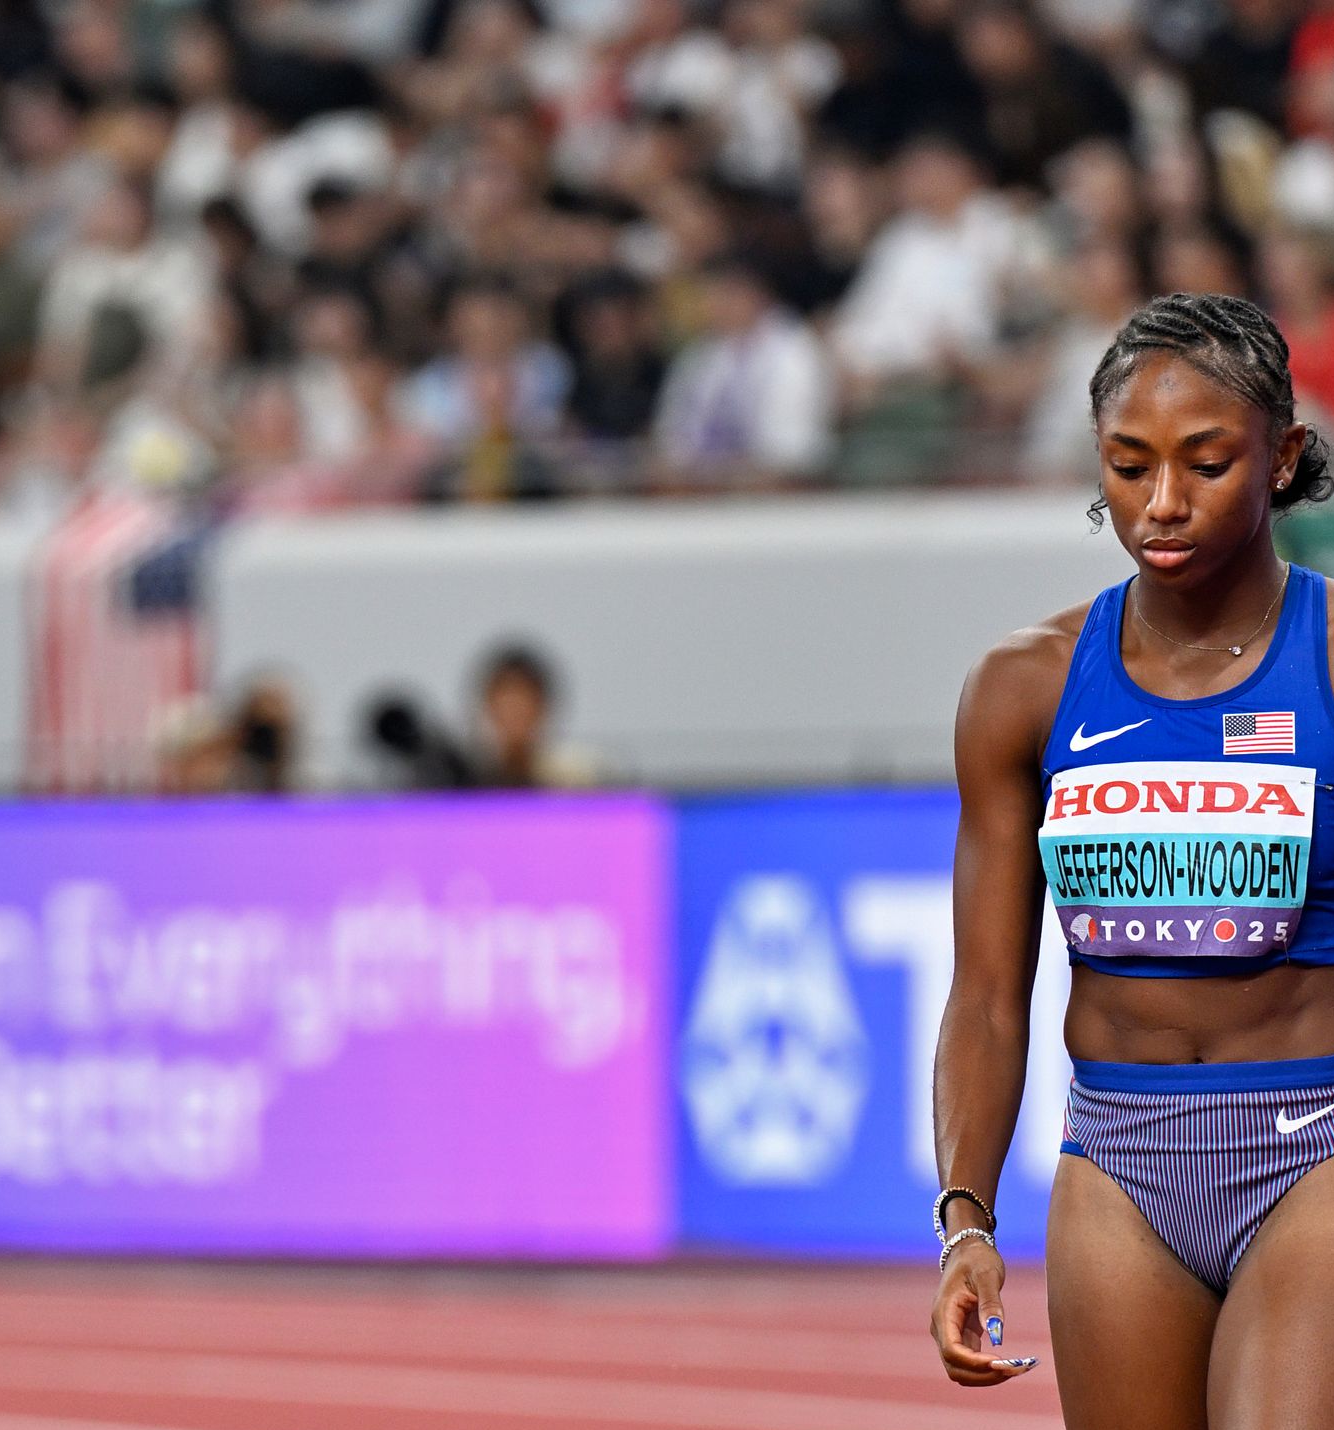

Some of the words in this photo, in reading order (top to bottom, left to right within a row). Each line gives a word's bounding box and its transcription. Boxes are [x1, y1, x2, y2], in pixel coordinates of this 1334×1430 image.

[1048, 781, 1305, 820] HONDA
[1054, 840, 1300, 899] JEFFERSON-WOODEN
[1247, 920, 1289, 942] 25
